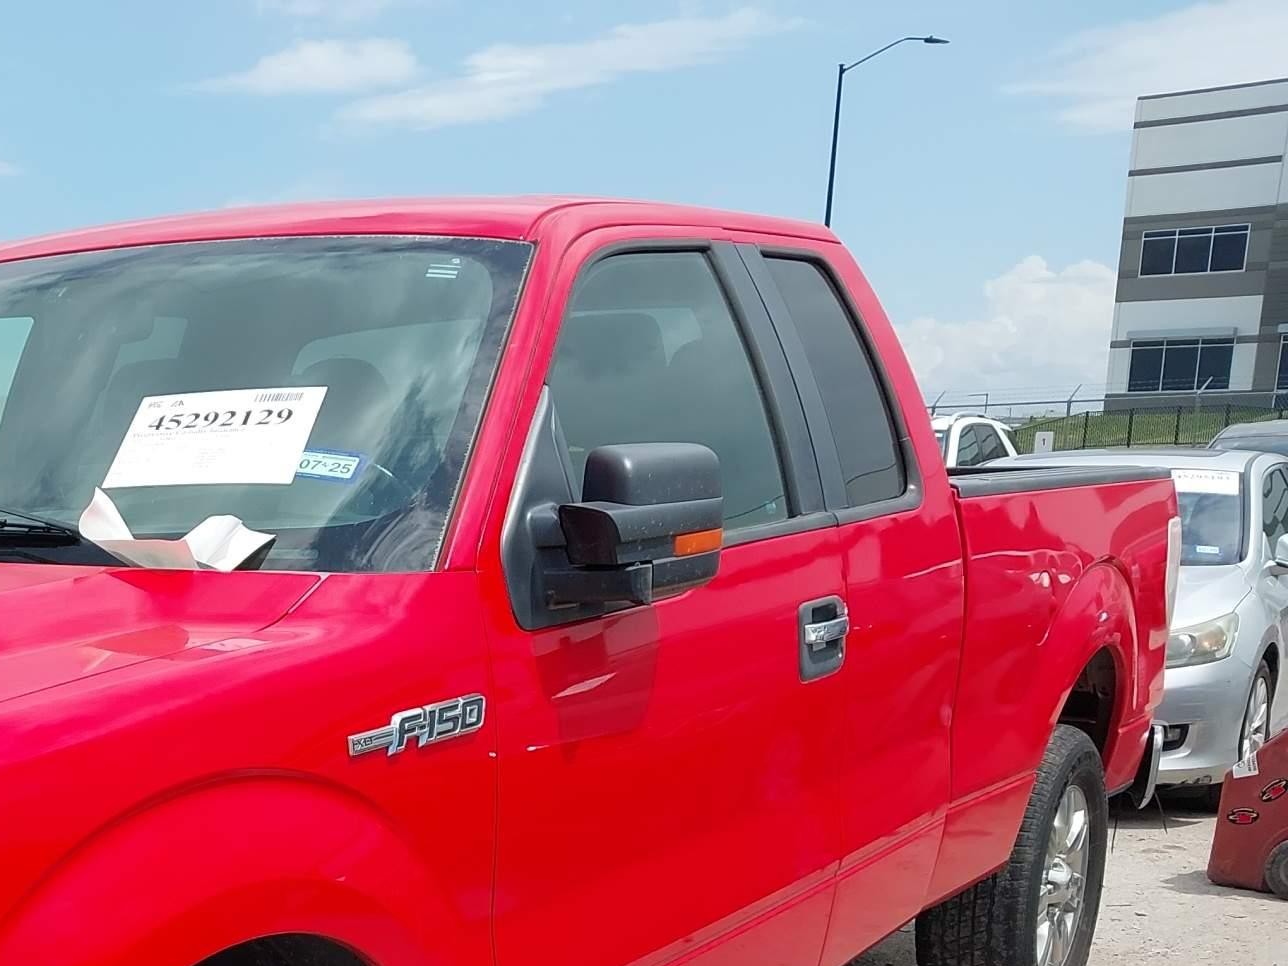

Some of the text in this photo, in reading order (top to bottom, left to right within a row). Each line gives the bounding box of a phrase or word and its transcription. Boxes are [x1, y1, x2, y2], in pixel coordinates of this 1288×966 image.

[148, 407, 294, 431] 45292129
[299, 458, 323, 471] 07
[328, 462, 353, 475] 25
[388, 694, 486, 756] F-150
